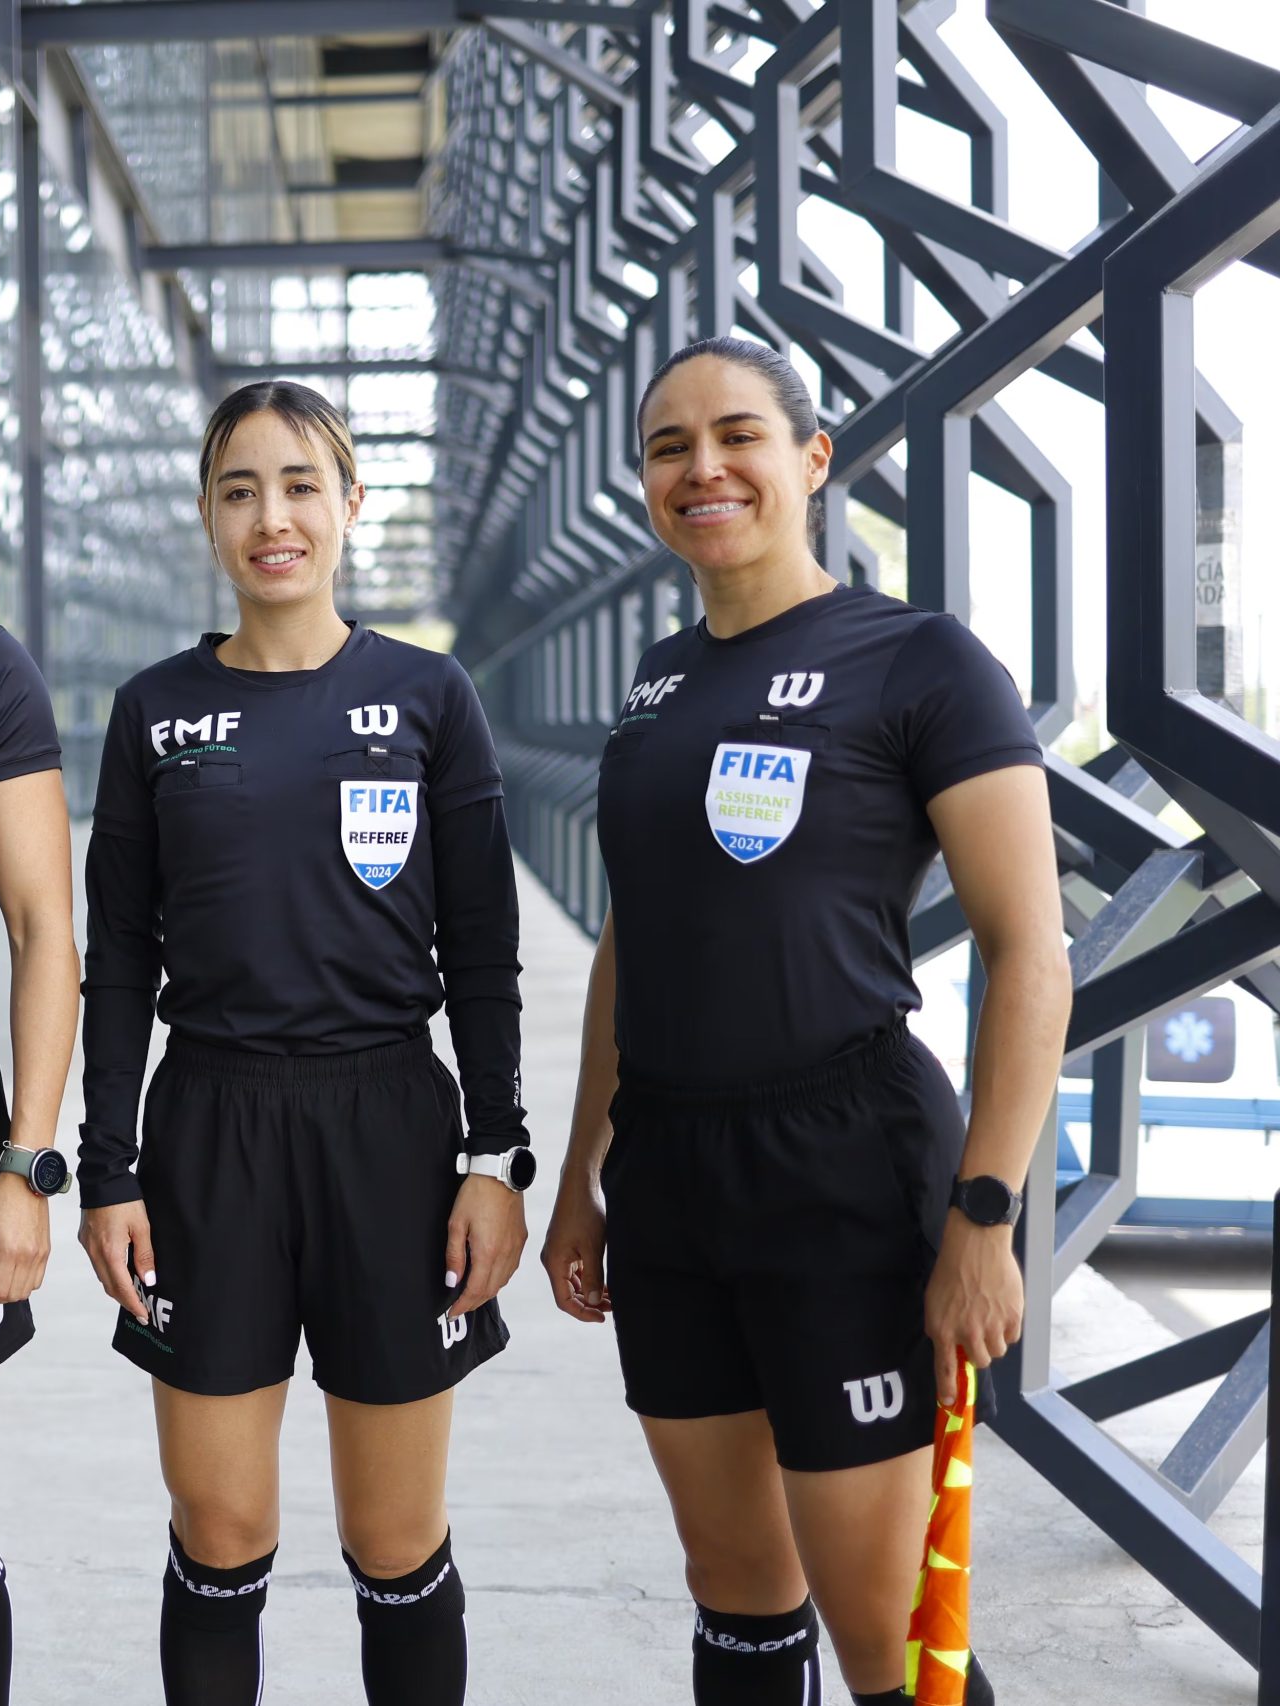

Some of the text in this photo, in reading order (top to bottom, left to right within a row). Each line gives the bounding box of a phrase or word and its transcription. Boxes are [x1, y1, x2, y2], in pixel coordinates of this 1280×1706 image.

[627, 673, 686, 712] FMF
[767, 672, 825, 708] W
[346, 704, 399, 736] W
[150, 711, 242, 758] FMF
[204, 743, 238, 753] FÚTBOL
[719, 750, 796, 784] FIFA
[349, 788, 412, 814] FIFA
[714, 790, 792, 810] ASSISTANT
[718, 804, 783, 823] REFEREE
[349, 831, 409, 845] REFEREE
[728, 835, 764, 852] 2024
[365, 866, 392, 879] 2024
[842, 1370, 904, 1423] W
